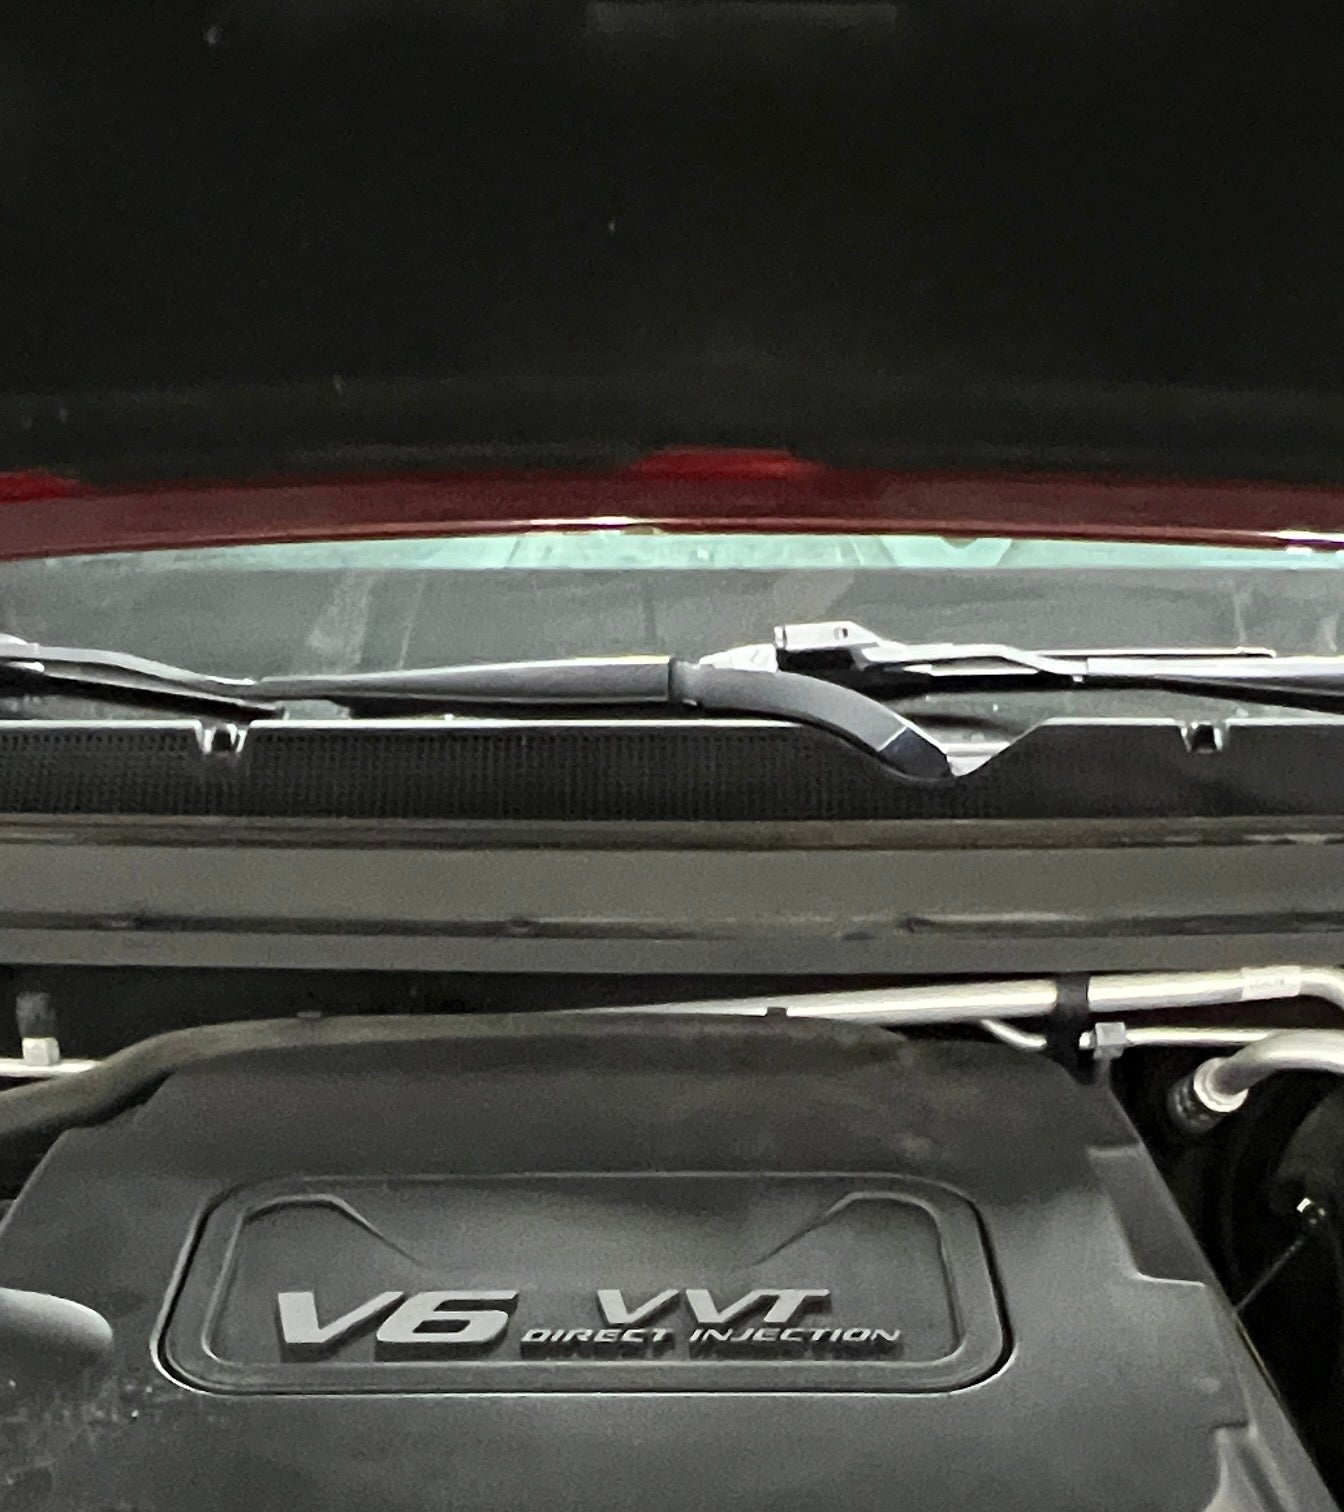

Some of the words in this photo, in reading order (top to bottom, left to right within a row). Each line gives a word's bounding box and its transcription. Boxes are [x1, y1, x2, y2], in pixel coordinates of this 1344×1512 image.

[277, 1289, 520, 1345] V6
[596, 1288, 832, 1324] VVT
[520, 1327, 675, 1343] DIRECT
[689, 1327, 902, 1343] INJECTION
